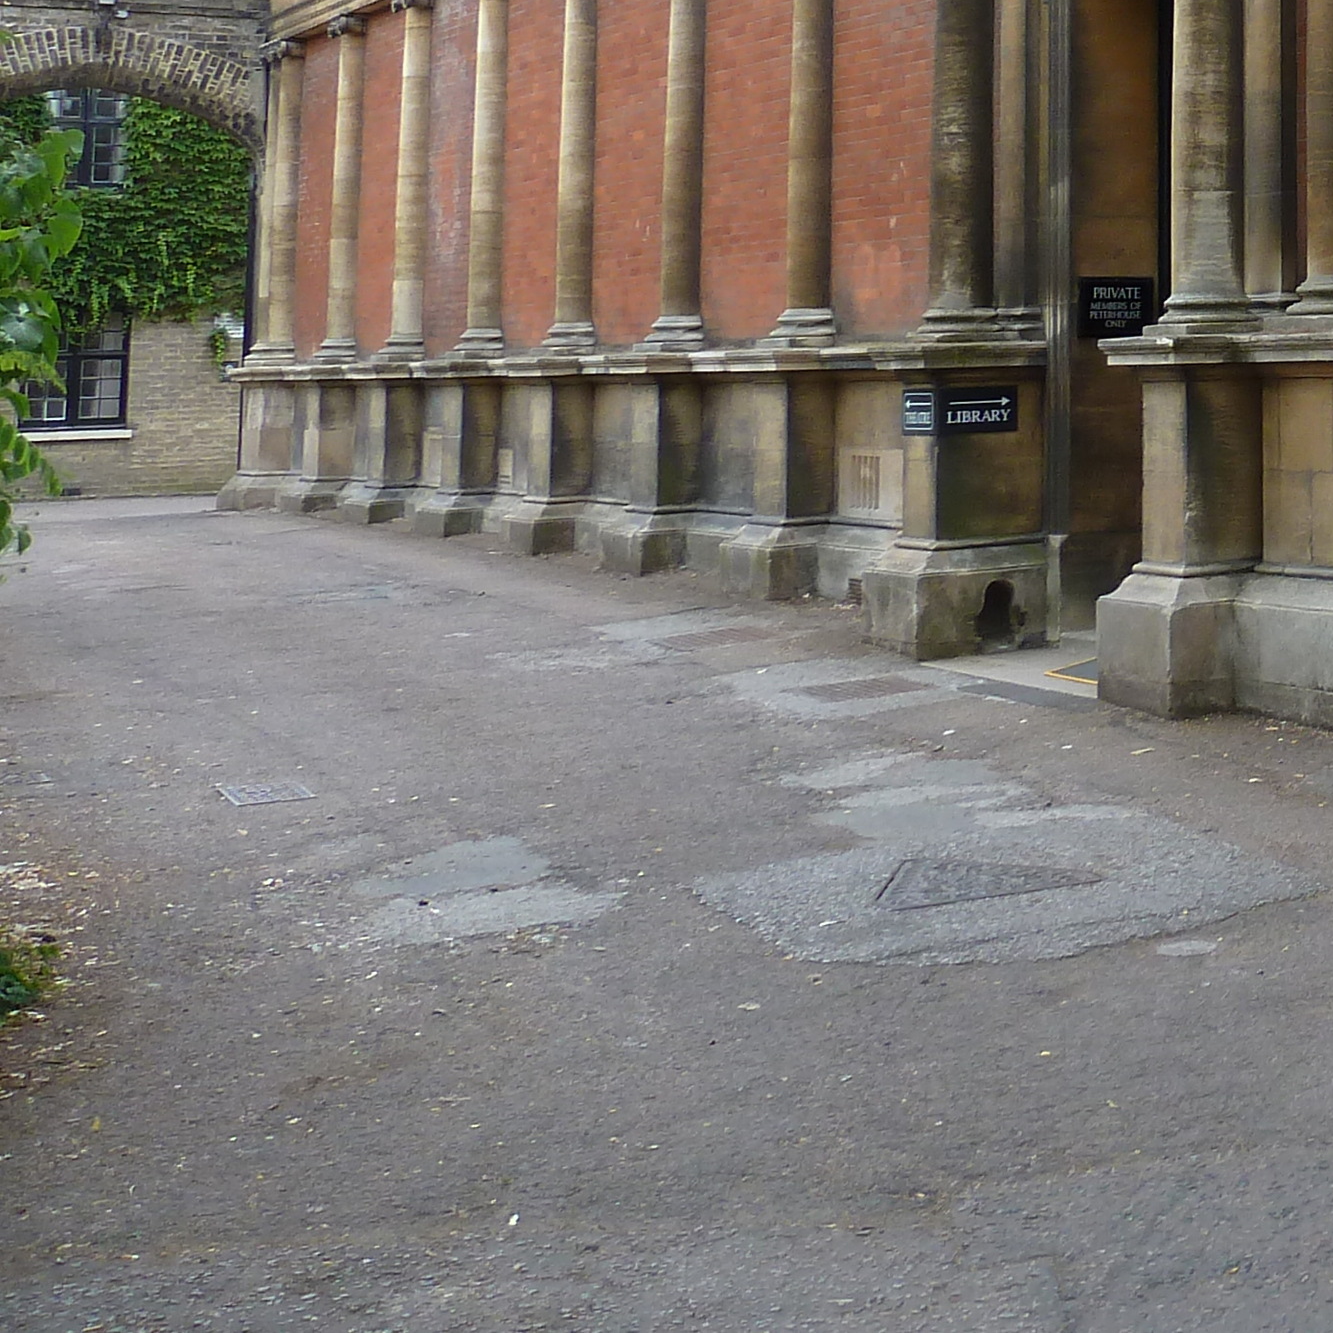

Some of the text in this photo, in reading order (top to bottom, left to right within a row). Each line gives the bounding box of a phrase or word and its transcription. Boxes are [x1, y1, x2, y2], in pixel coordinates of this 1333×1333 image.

[1093, 287, 1142, 299] PRIVATE
[1130, 302, 1141, 310] OF
[1089, 311, 1141, 319] PETERHOUSE
[1105, 320, 1127, 328] ONLY
[946, 409, 1011, 424] LIBRARY
